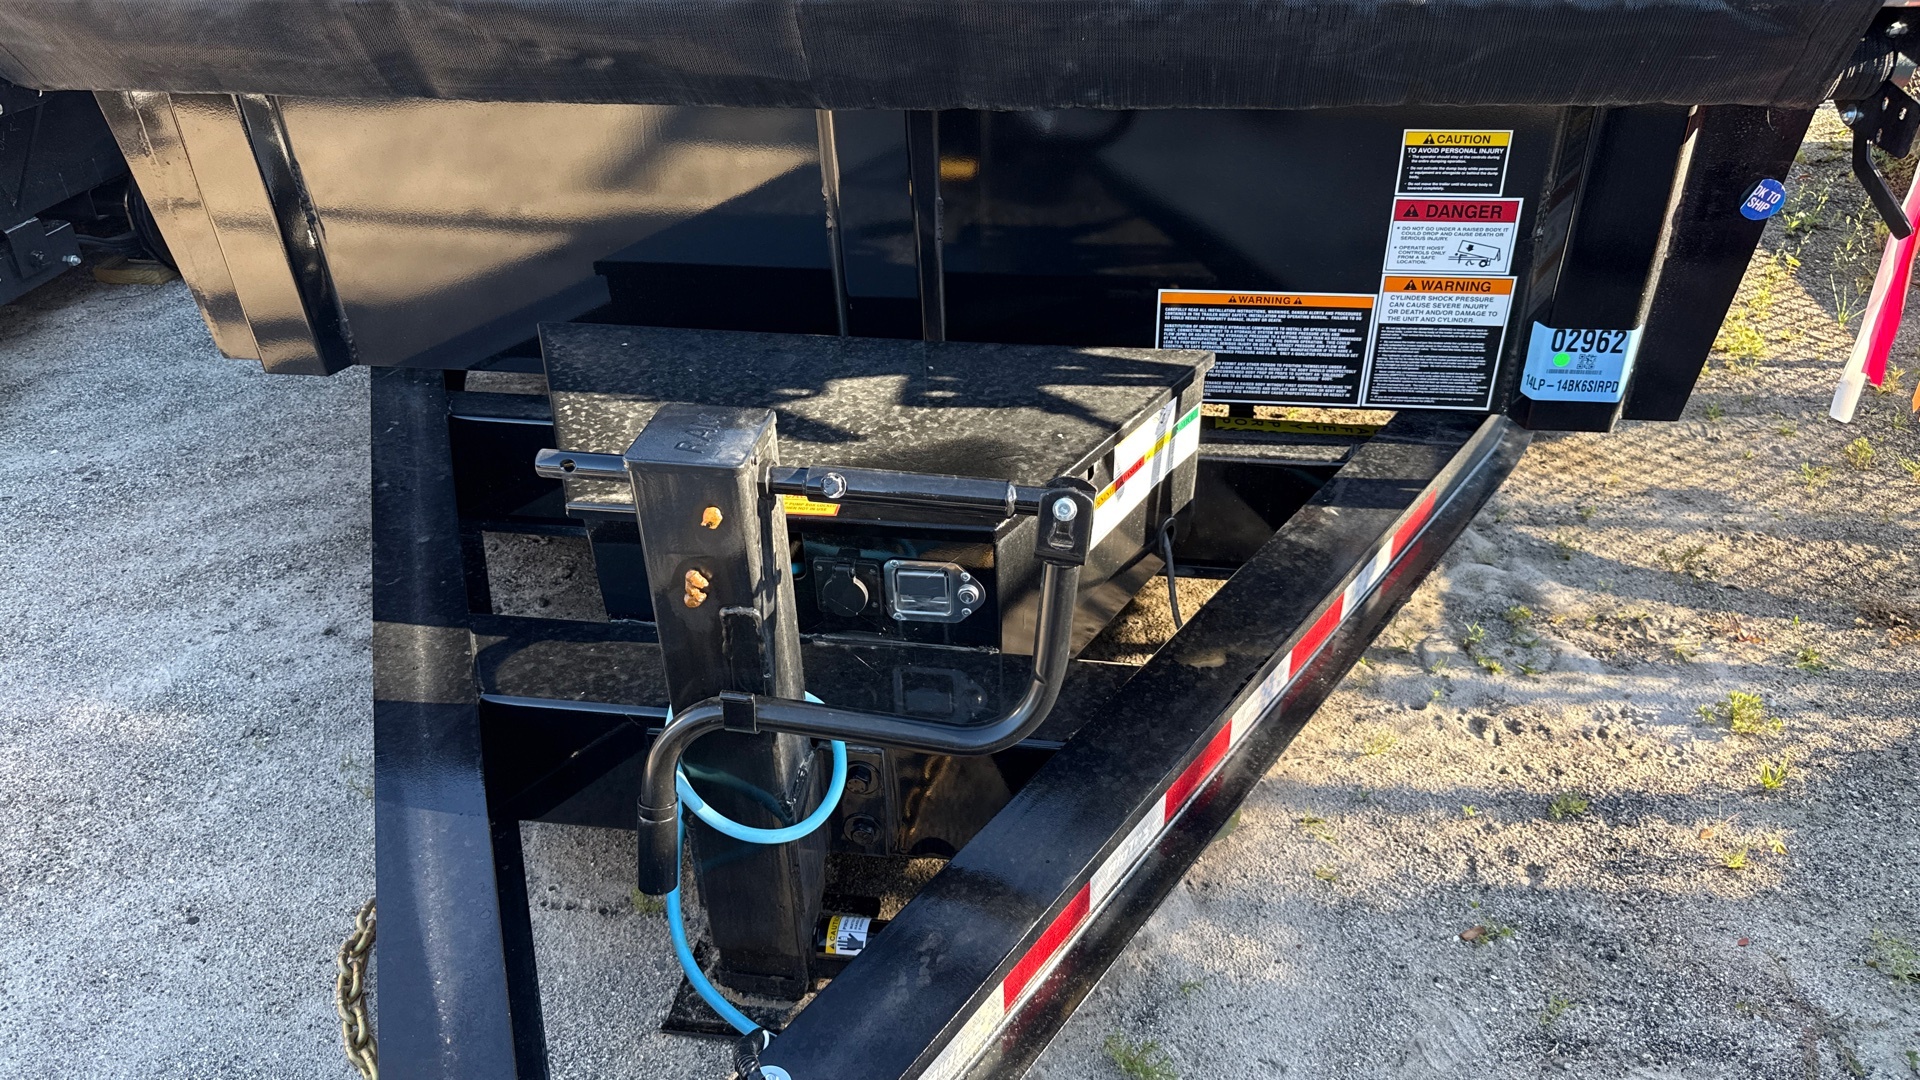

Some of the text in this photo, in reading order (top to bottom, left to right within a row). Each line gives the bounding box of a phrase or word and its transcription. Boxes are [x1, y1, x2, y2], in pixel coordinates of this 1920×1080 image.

[1436, 134, 1491, 144] CAUTION
[1753, 185, 1781, 204] OK TO
[1426, 204, 1503, 219] DANGER
[1747, 197, 1770, 212] SHIP
[1421, 280, 1491, 292] WARNING
[1238, 296, 1291, 305] WARNING
[1551, 329, 1627, 353] 02962
[1526, 374, 1545, 391] 14LP
[1557, 379, 1619, 393] 14BK6SIRPD
[1290, 423, 1379, 434] AFETY
[830, 916, 841, 941] CAUTIO
